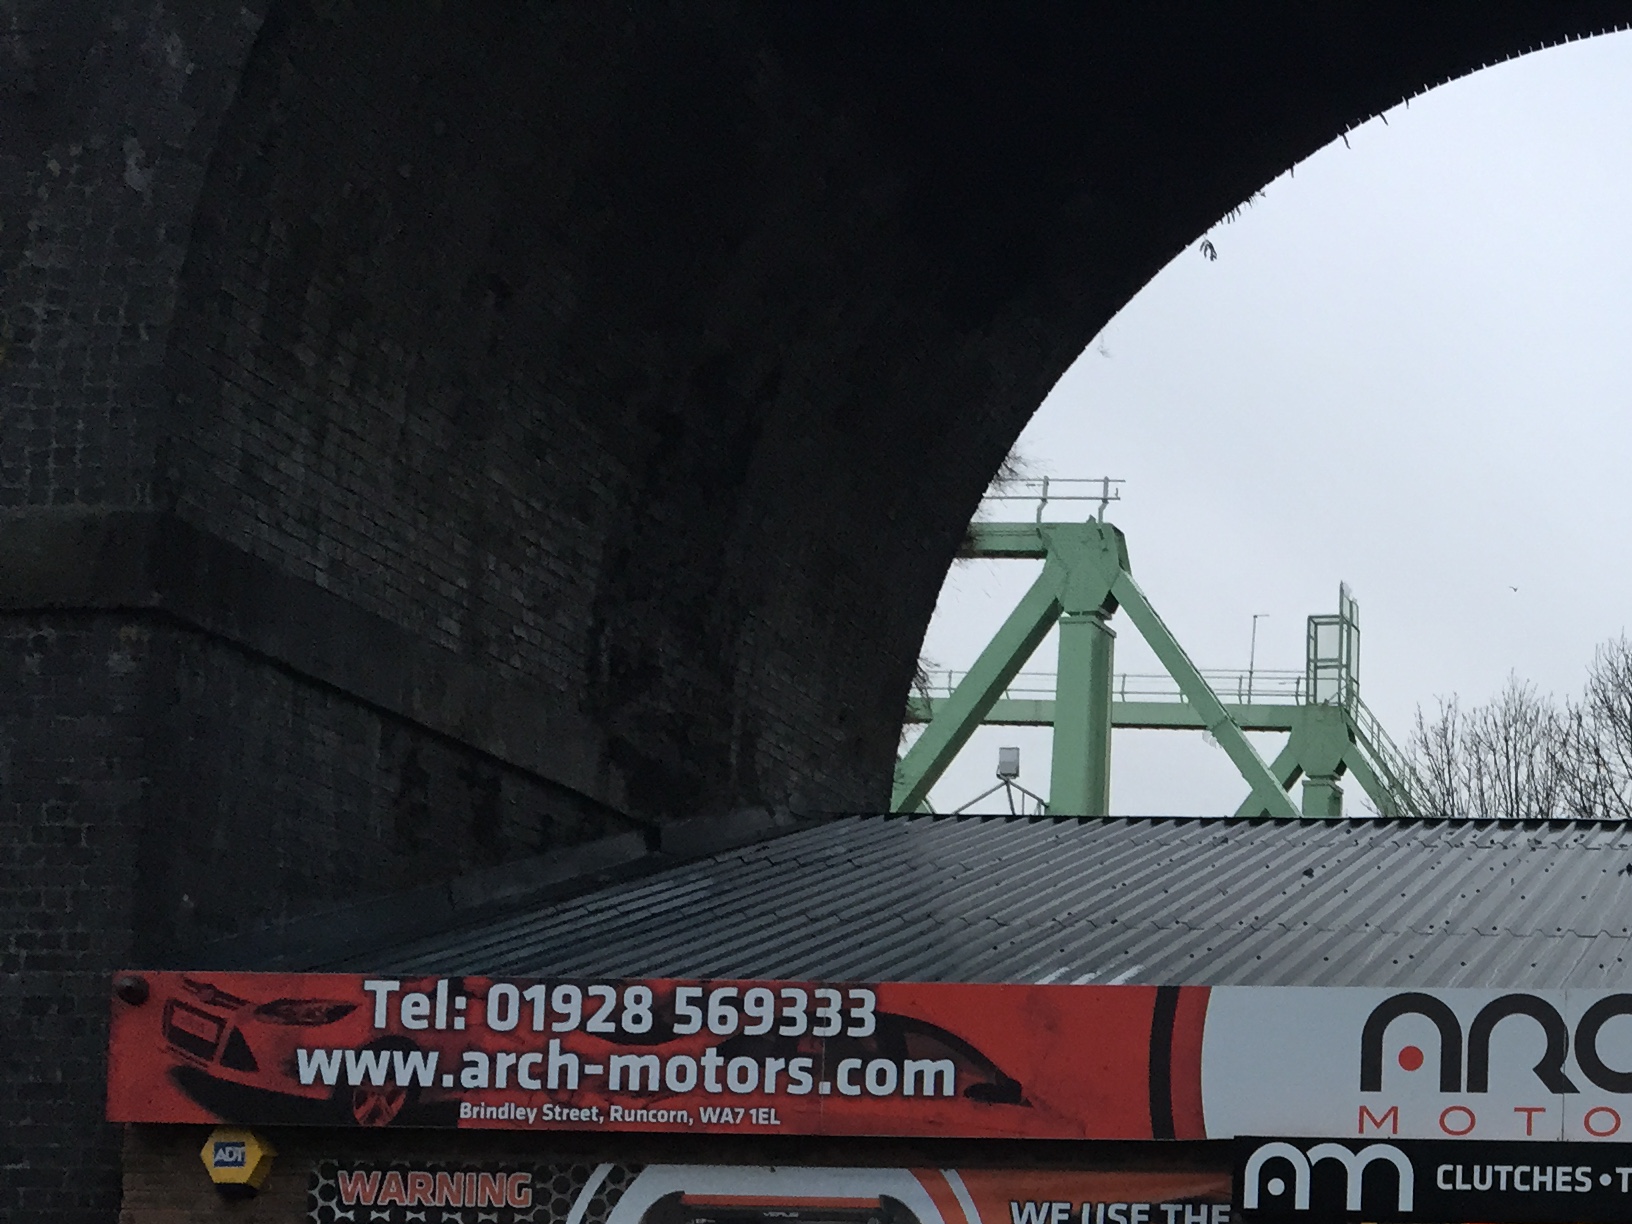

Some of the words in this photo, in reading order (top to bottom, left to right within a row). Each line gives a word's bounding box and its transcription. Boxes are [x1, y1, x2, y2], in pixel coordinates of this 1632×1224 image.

[364, 978, 467, 1031] Tel:
[486, 983, 653, 1034] 01928
[672, 986, 877, 1038] 569333
[296, 1038, 956, 1097] www.arch-motors.com
[459, 1101, 537, 1125] Brindley
[542, 1103, 605, 1125] Street,
[609, 1105, 694, 1127] Runcorn,
[699, 1107, 744, 1125] WA7
[749, 1108, 781, 1126] 1EL
[214, 1146, 246, 1162] ADT
[337, 1170, 533, 1208] WARNING
[1435, 1163, 1593, 1193] CLUTCHES
